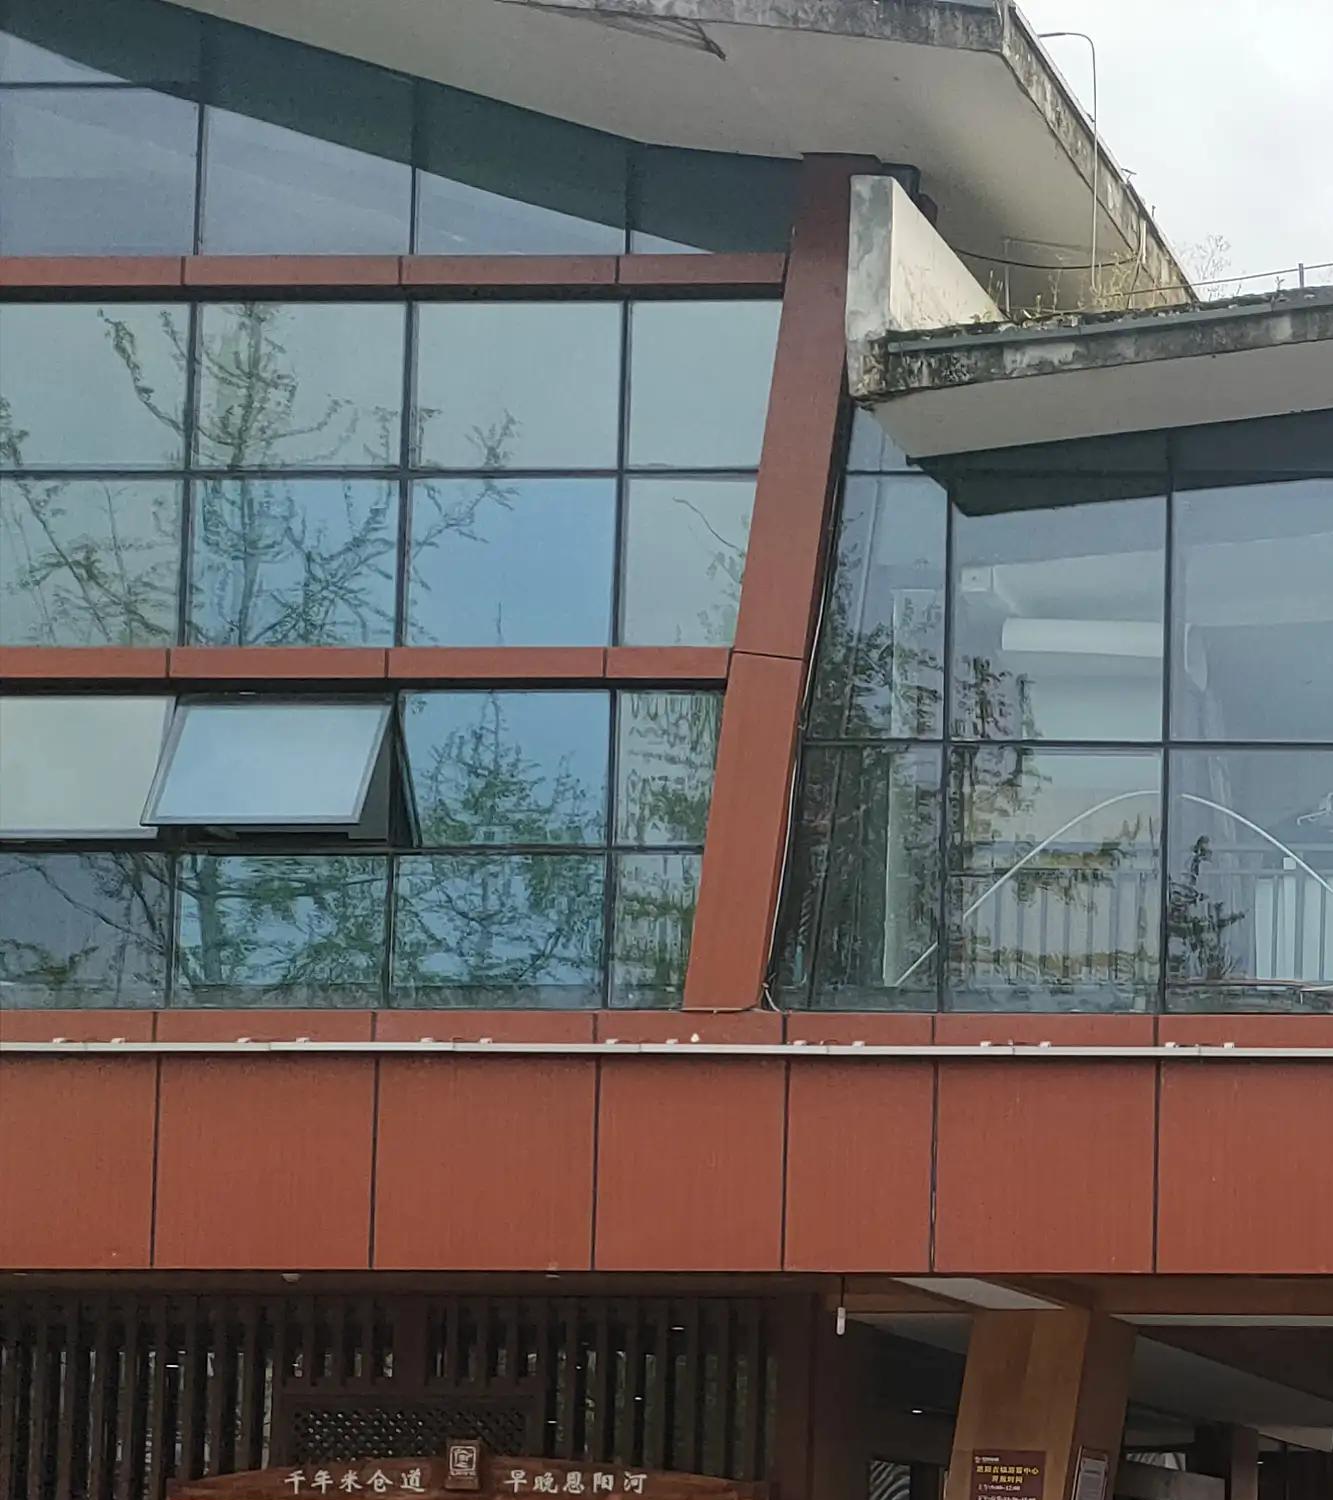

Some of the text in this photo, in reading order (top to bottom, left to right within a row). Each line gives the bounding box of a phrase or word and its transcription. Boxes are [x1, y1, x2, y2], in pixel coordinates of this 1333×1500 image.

[284, 1468, 648, 1495] 千年米仓道 早晚恩阳河
